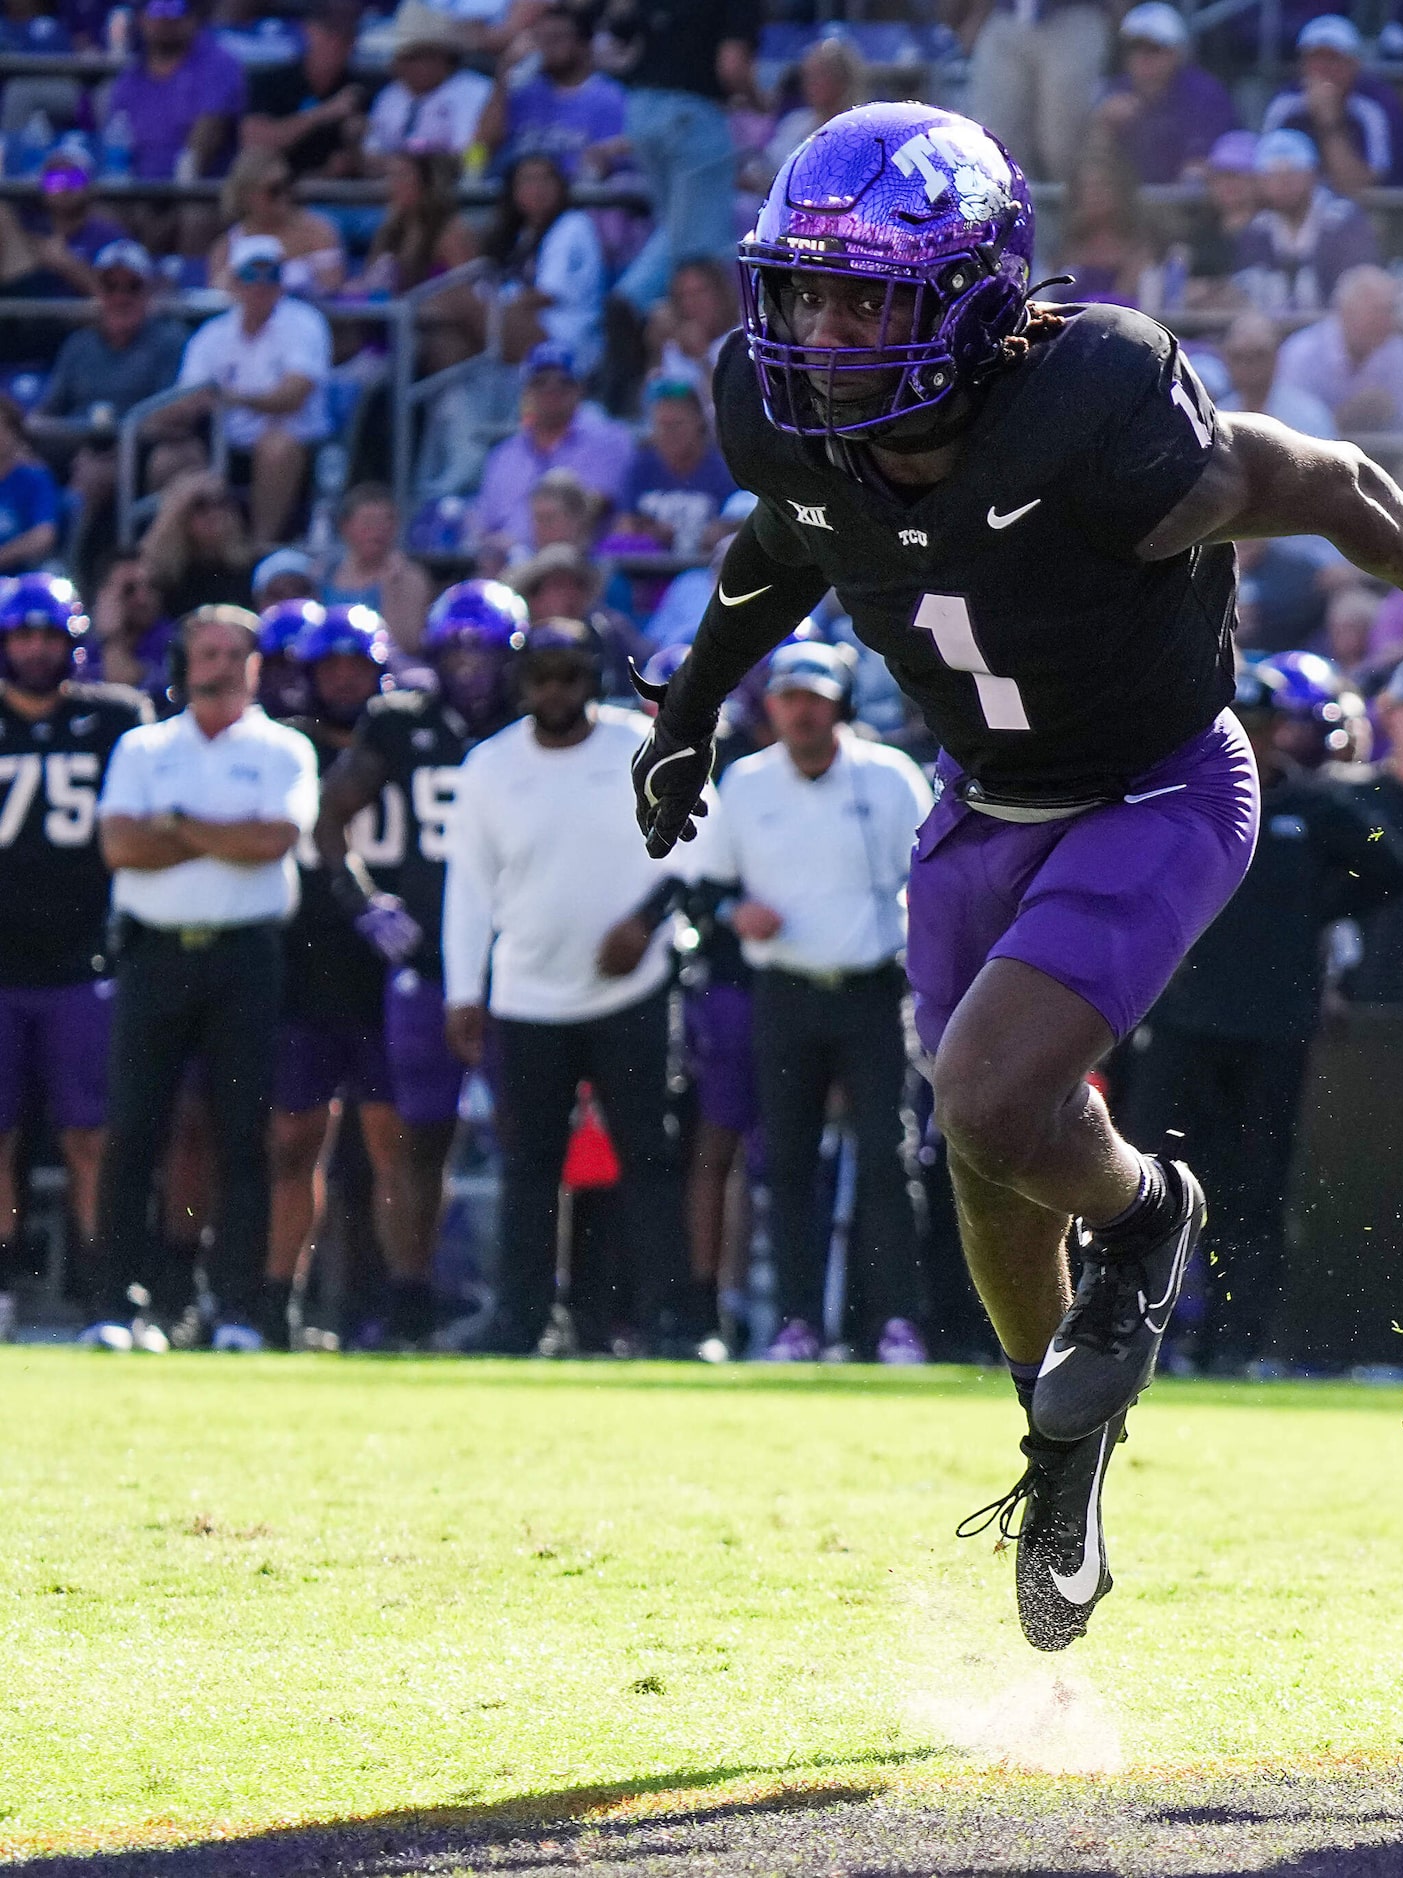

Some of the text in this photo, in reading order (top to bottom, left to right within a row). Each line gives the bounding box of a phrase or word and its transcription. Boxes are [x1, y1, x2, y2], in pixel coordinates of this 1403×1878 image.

[898, 528, 928, 548] TCU
[913, 592, 1031, 730] 1
[0, 752, 98, 847] 75
